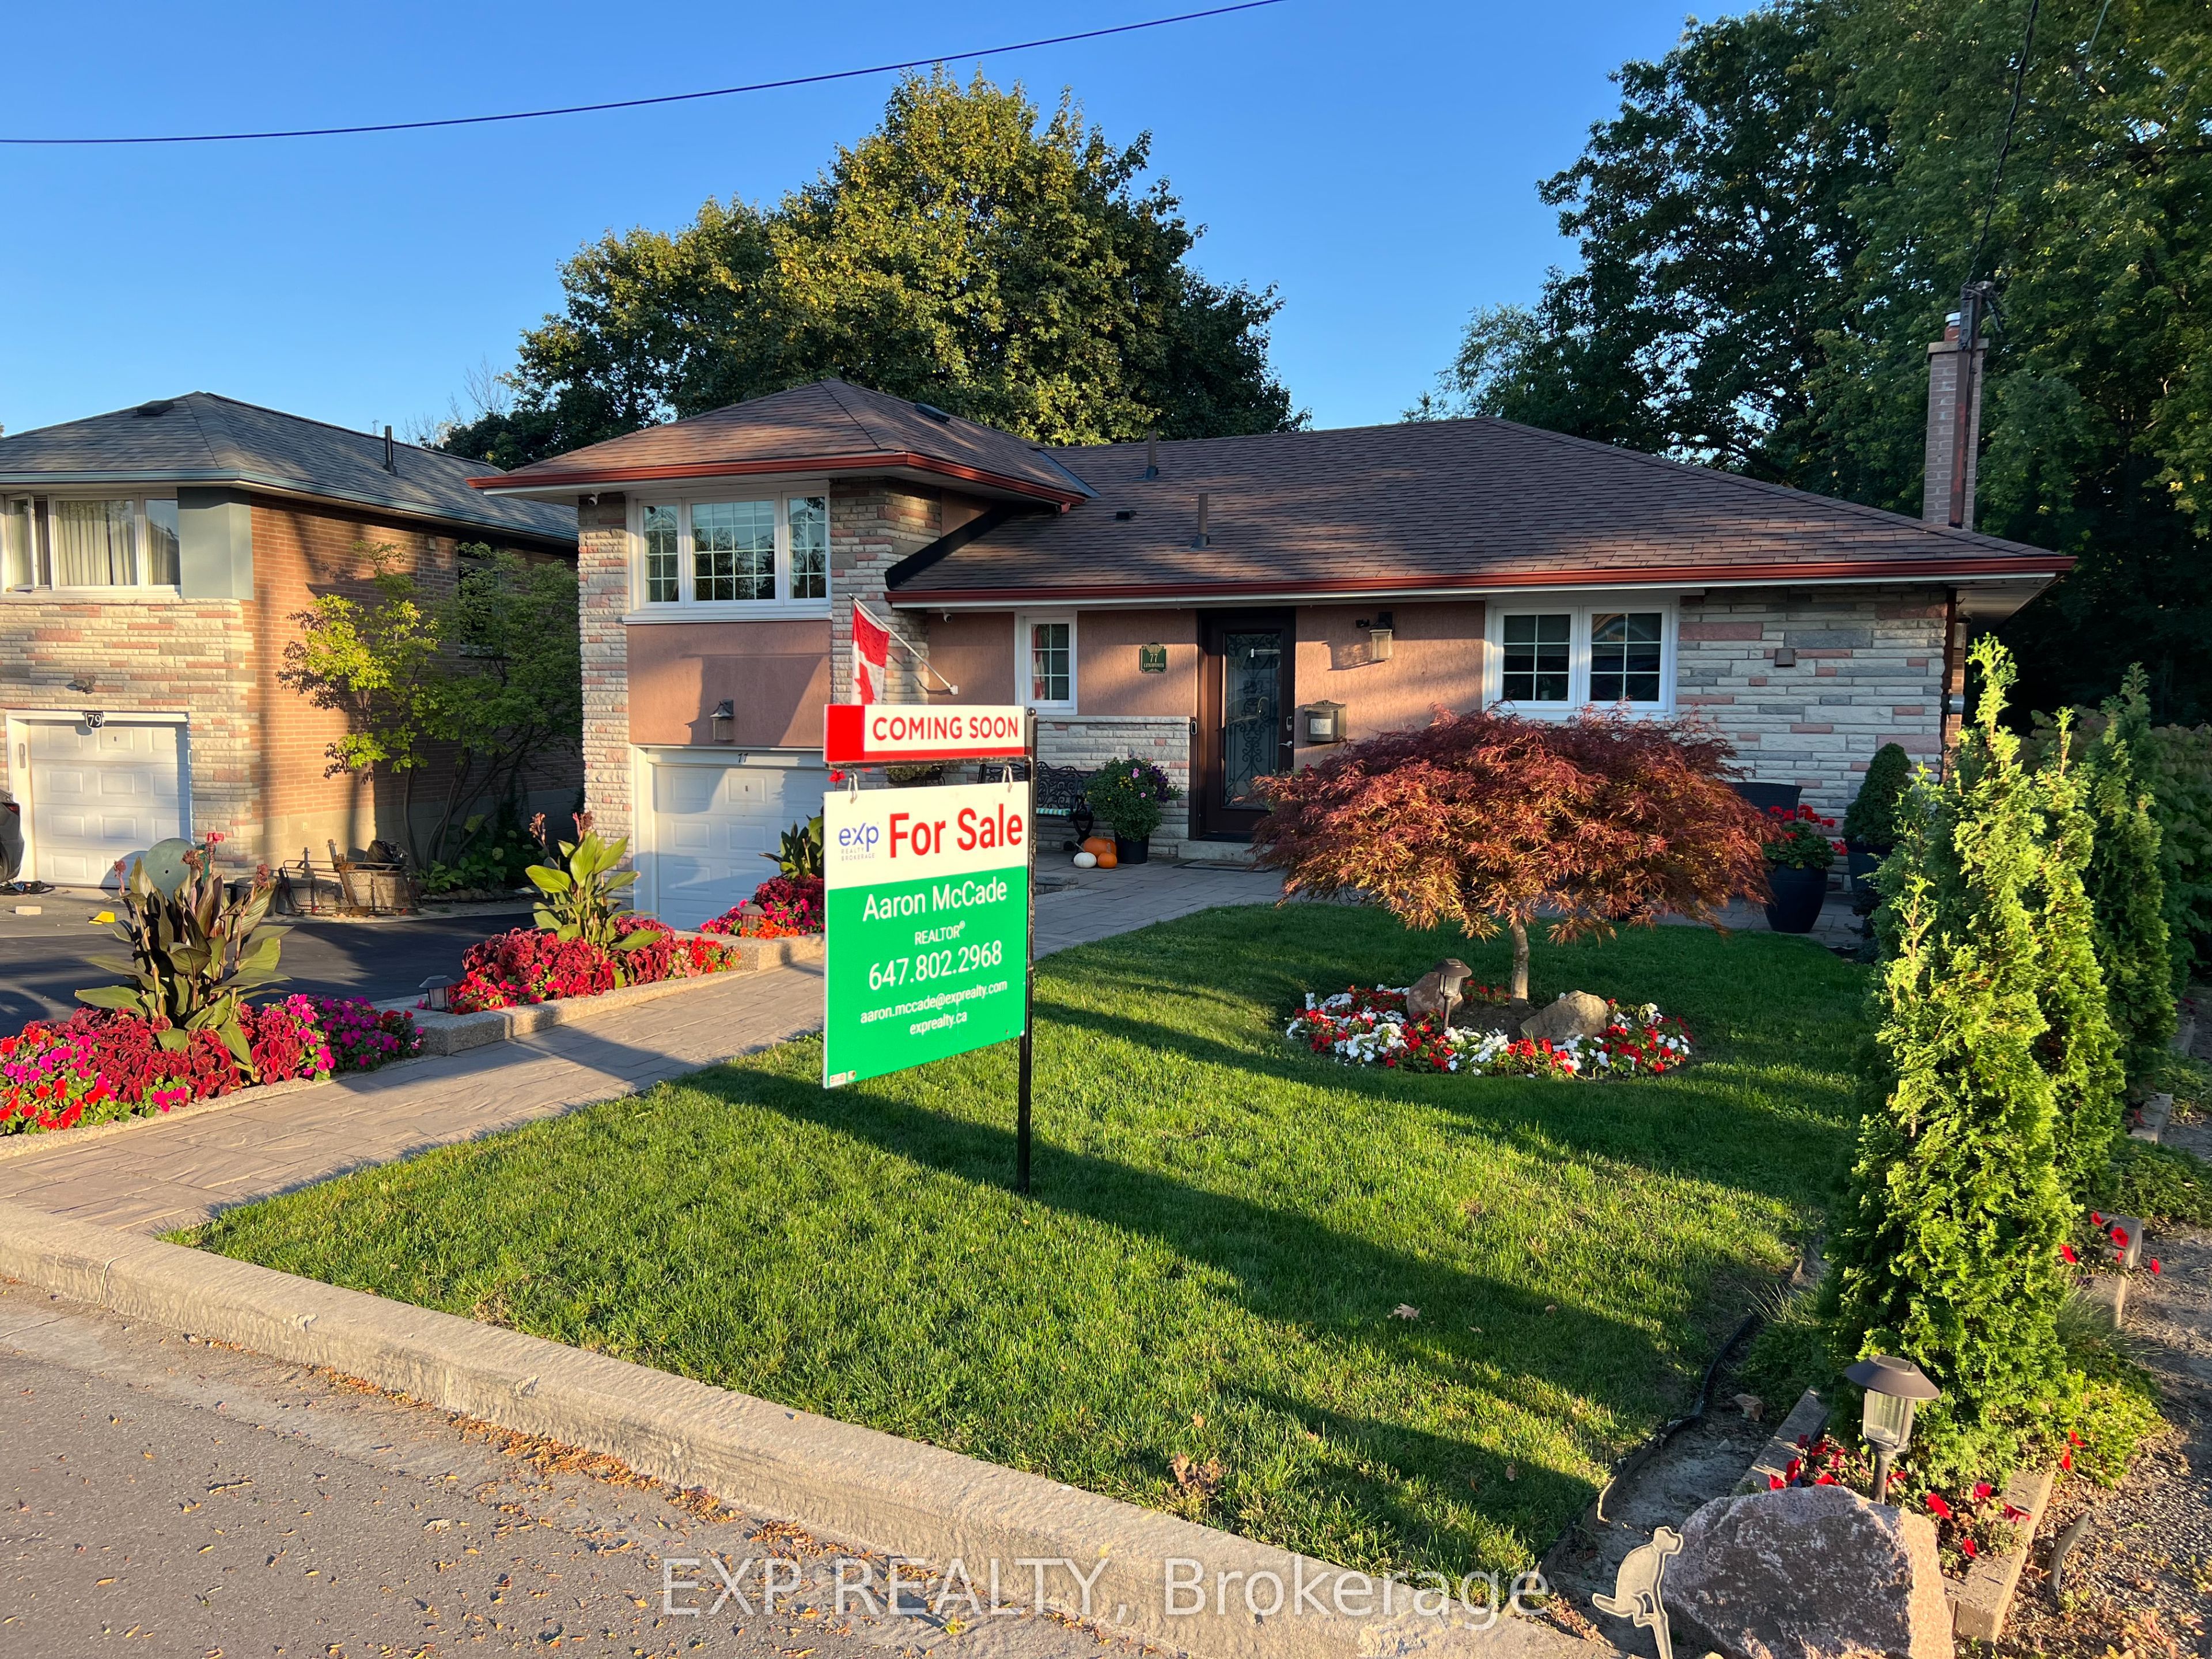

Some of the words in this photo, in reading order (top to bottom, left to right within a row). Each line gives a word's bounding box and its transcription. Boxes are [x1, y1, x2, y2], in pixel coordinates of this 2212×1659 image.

[1149, 653, 1158, 663] 77
[88, 714, 101, 726] 79
[873, 717, 962, 741] COMING
[969, 717, 1018, 739] SOON
[889, 812, 946, 858] For
[957, 803, 1022, 851] Sale
[841, 853, 875, 861] BROKERAGE
[862, 893, 926, 922] Aaron
[932, 876, 1007, 911] McCade
[869, 940, 1002, 991] 647.802.2968
[860, 980, 1007, 1024] aaron.mccade@exprealty.com
[910, 1012, 967, 1035] exprealty.ca
